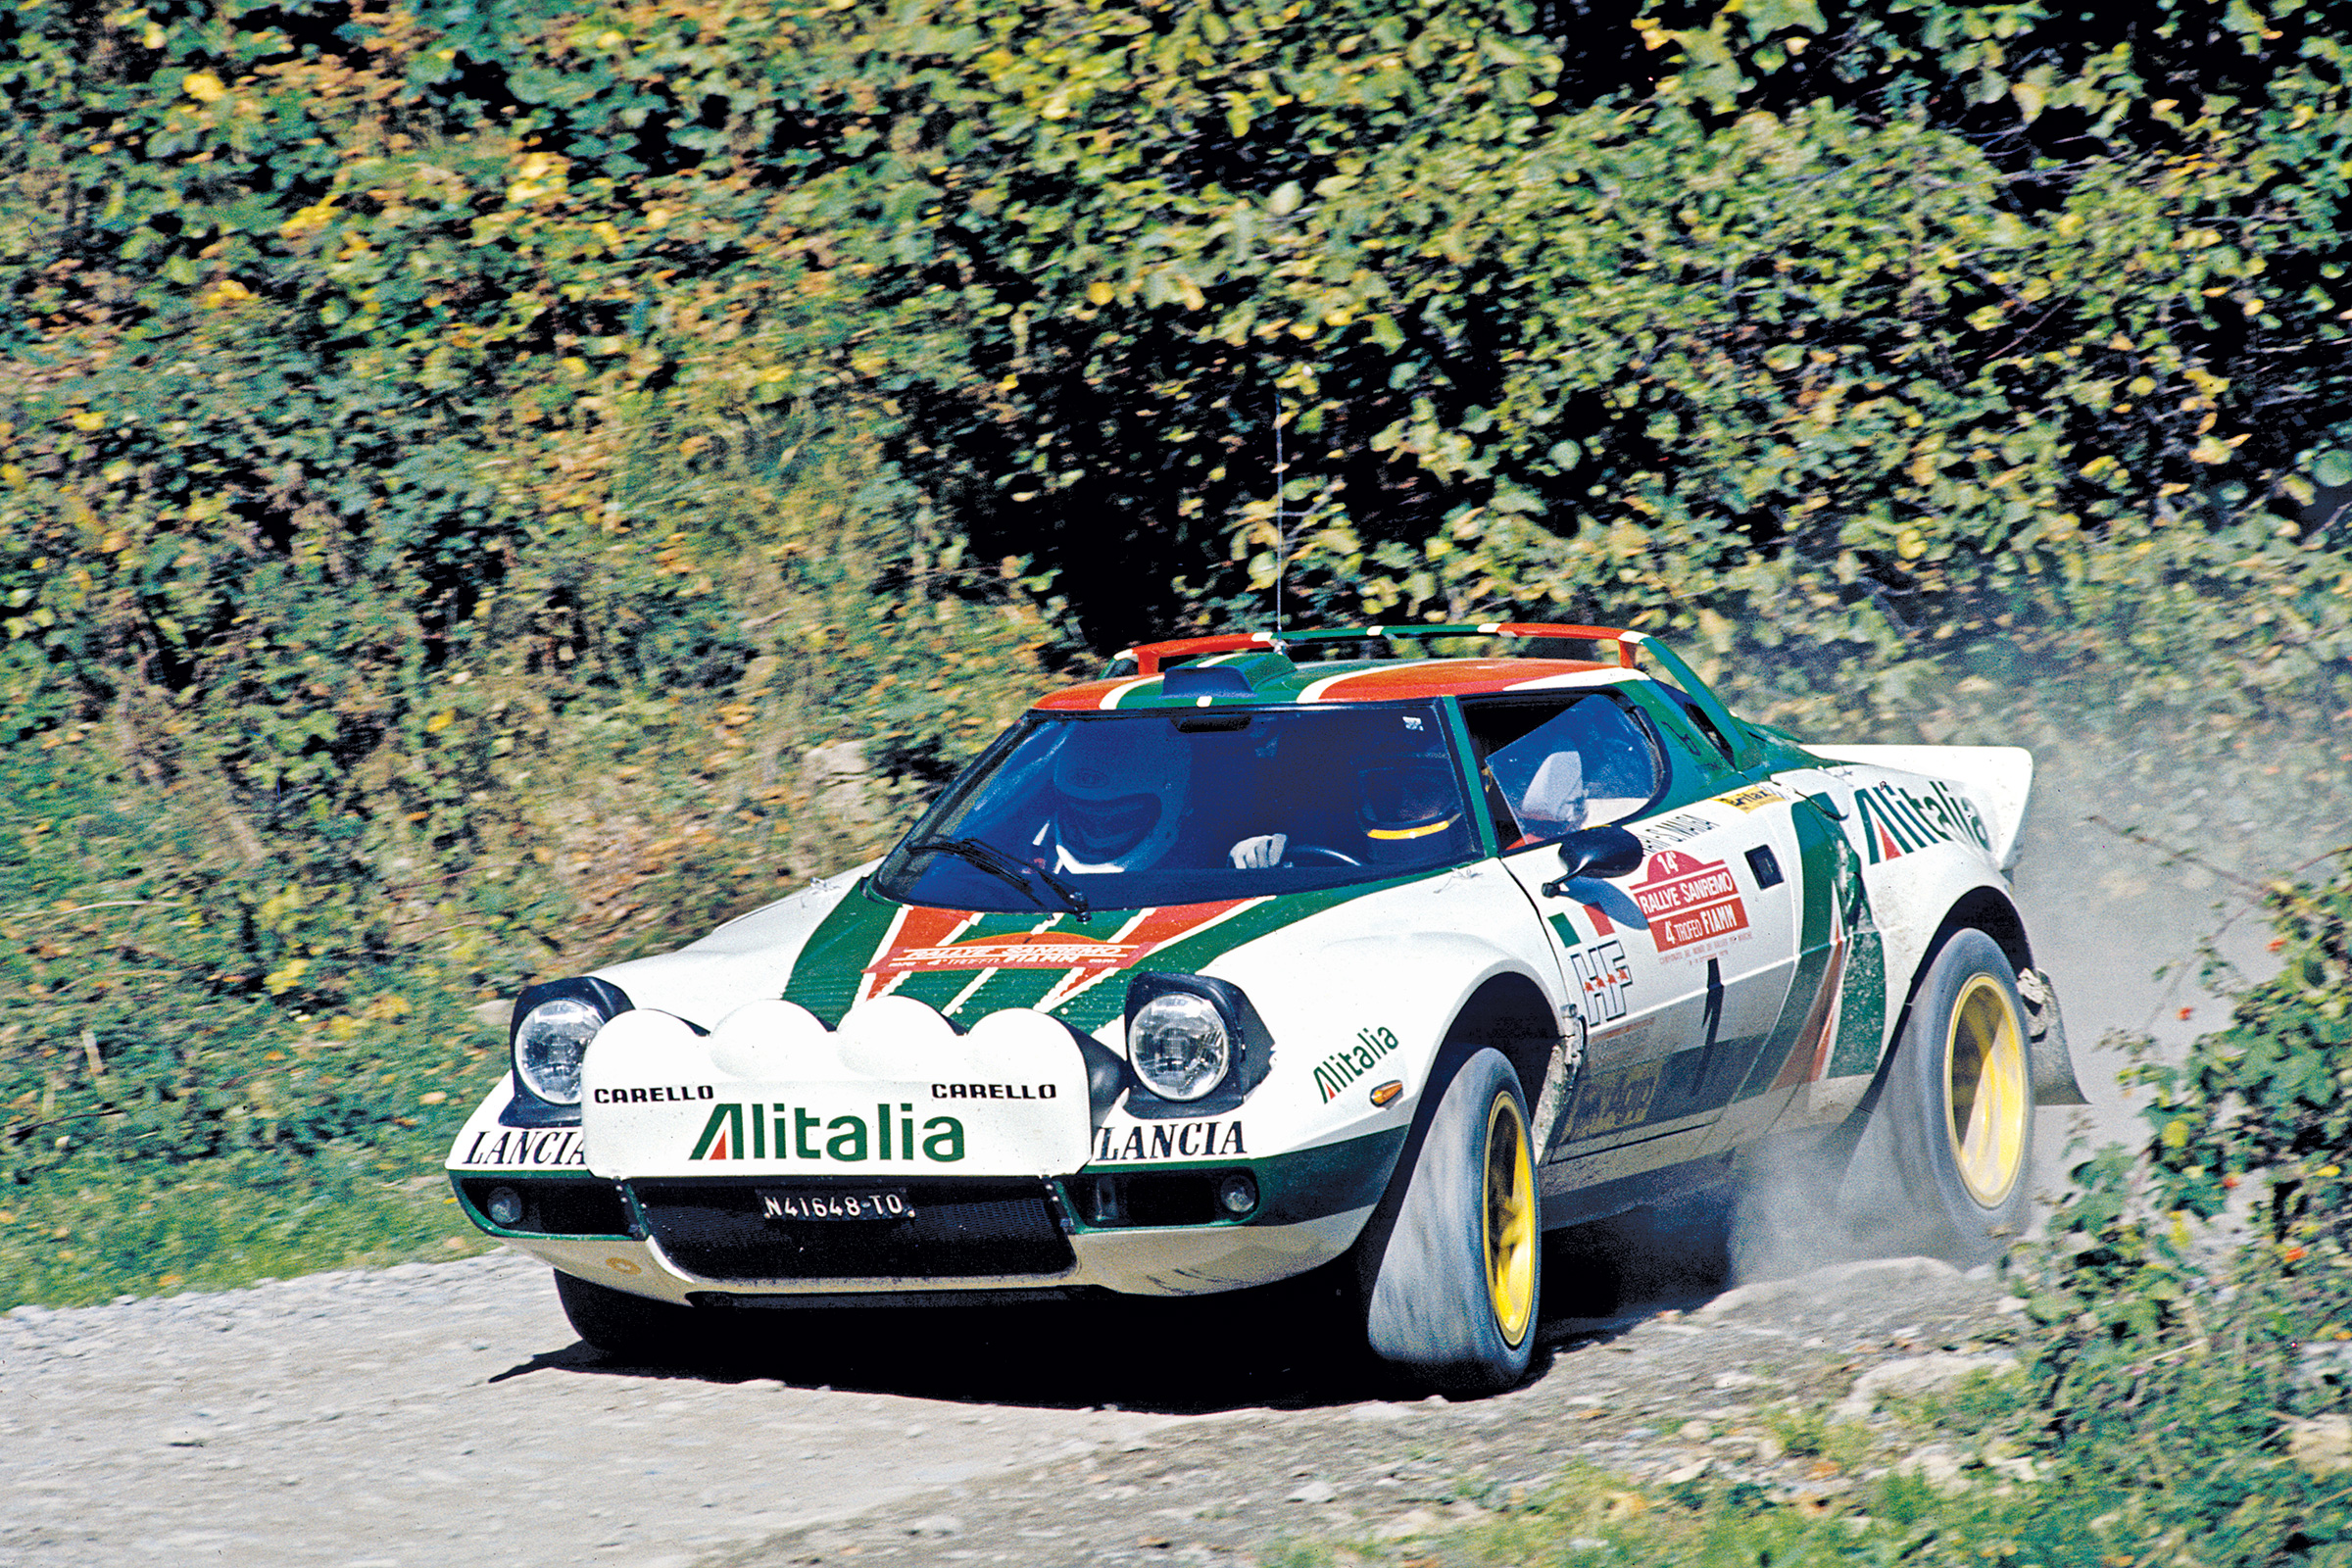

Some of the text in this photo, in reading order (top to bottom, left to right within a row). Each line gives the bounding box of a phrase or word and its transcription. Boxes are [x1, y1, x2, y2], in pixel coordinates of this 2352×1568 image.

[1854, 780, 1991, 865] Alitalia
[1639, 872, 1733, 914] RALLYE SANREMO
[1674, 919, 1703, 942] TROFEO
[1699, 904, 1738, 934] FIAMM
[1570, 939, 1634, 1028] HF
[1313, 1026, 1399, 1104] Alitalia
[594, 1085, 714, 1103] CARELLO
[931, 1083, 1057, 1100] CARELLO
[688, 1102, 965, 1163] Alitalia
[1095, 1120, 1249, 1162] LANCIA
